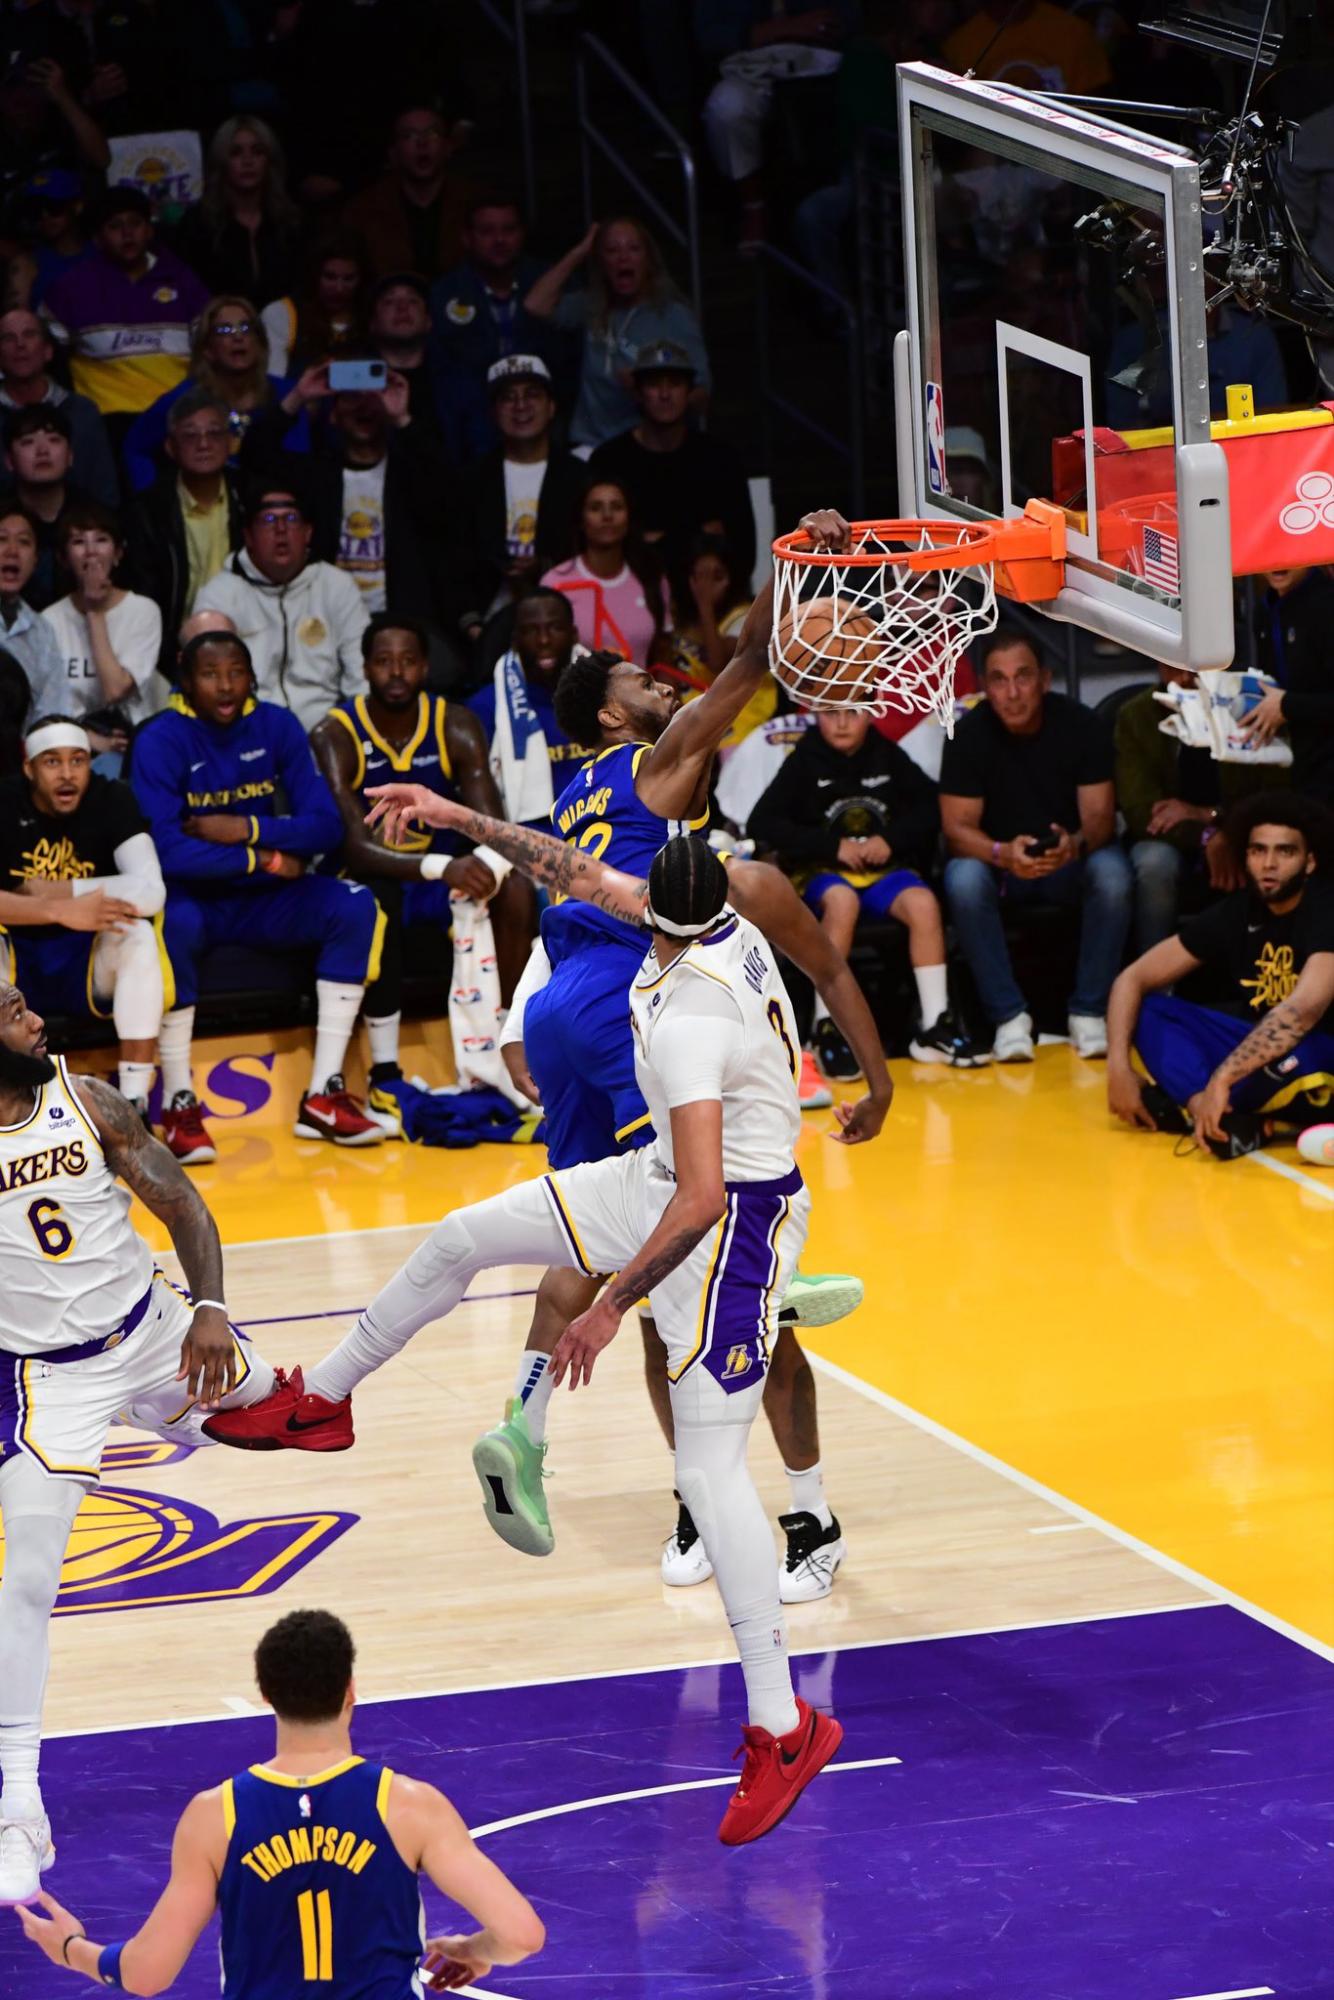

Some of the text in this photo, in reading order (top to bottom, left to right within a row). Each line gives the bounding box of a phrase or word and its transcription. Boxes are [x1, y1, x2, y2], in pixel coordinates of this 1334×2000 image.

[26, 1196, 76, 1262] 6
[240, 1825, 377, 1882] THOMPSON
[297, 1889, 333, 1981] 11
